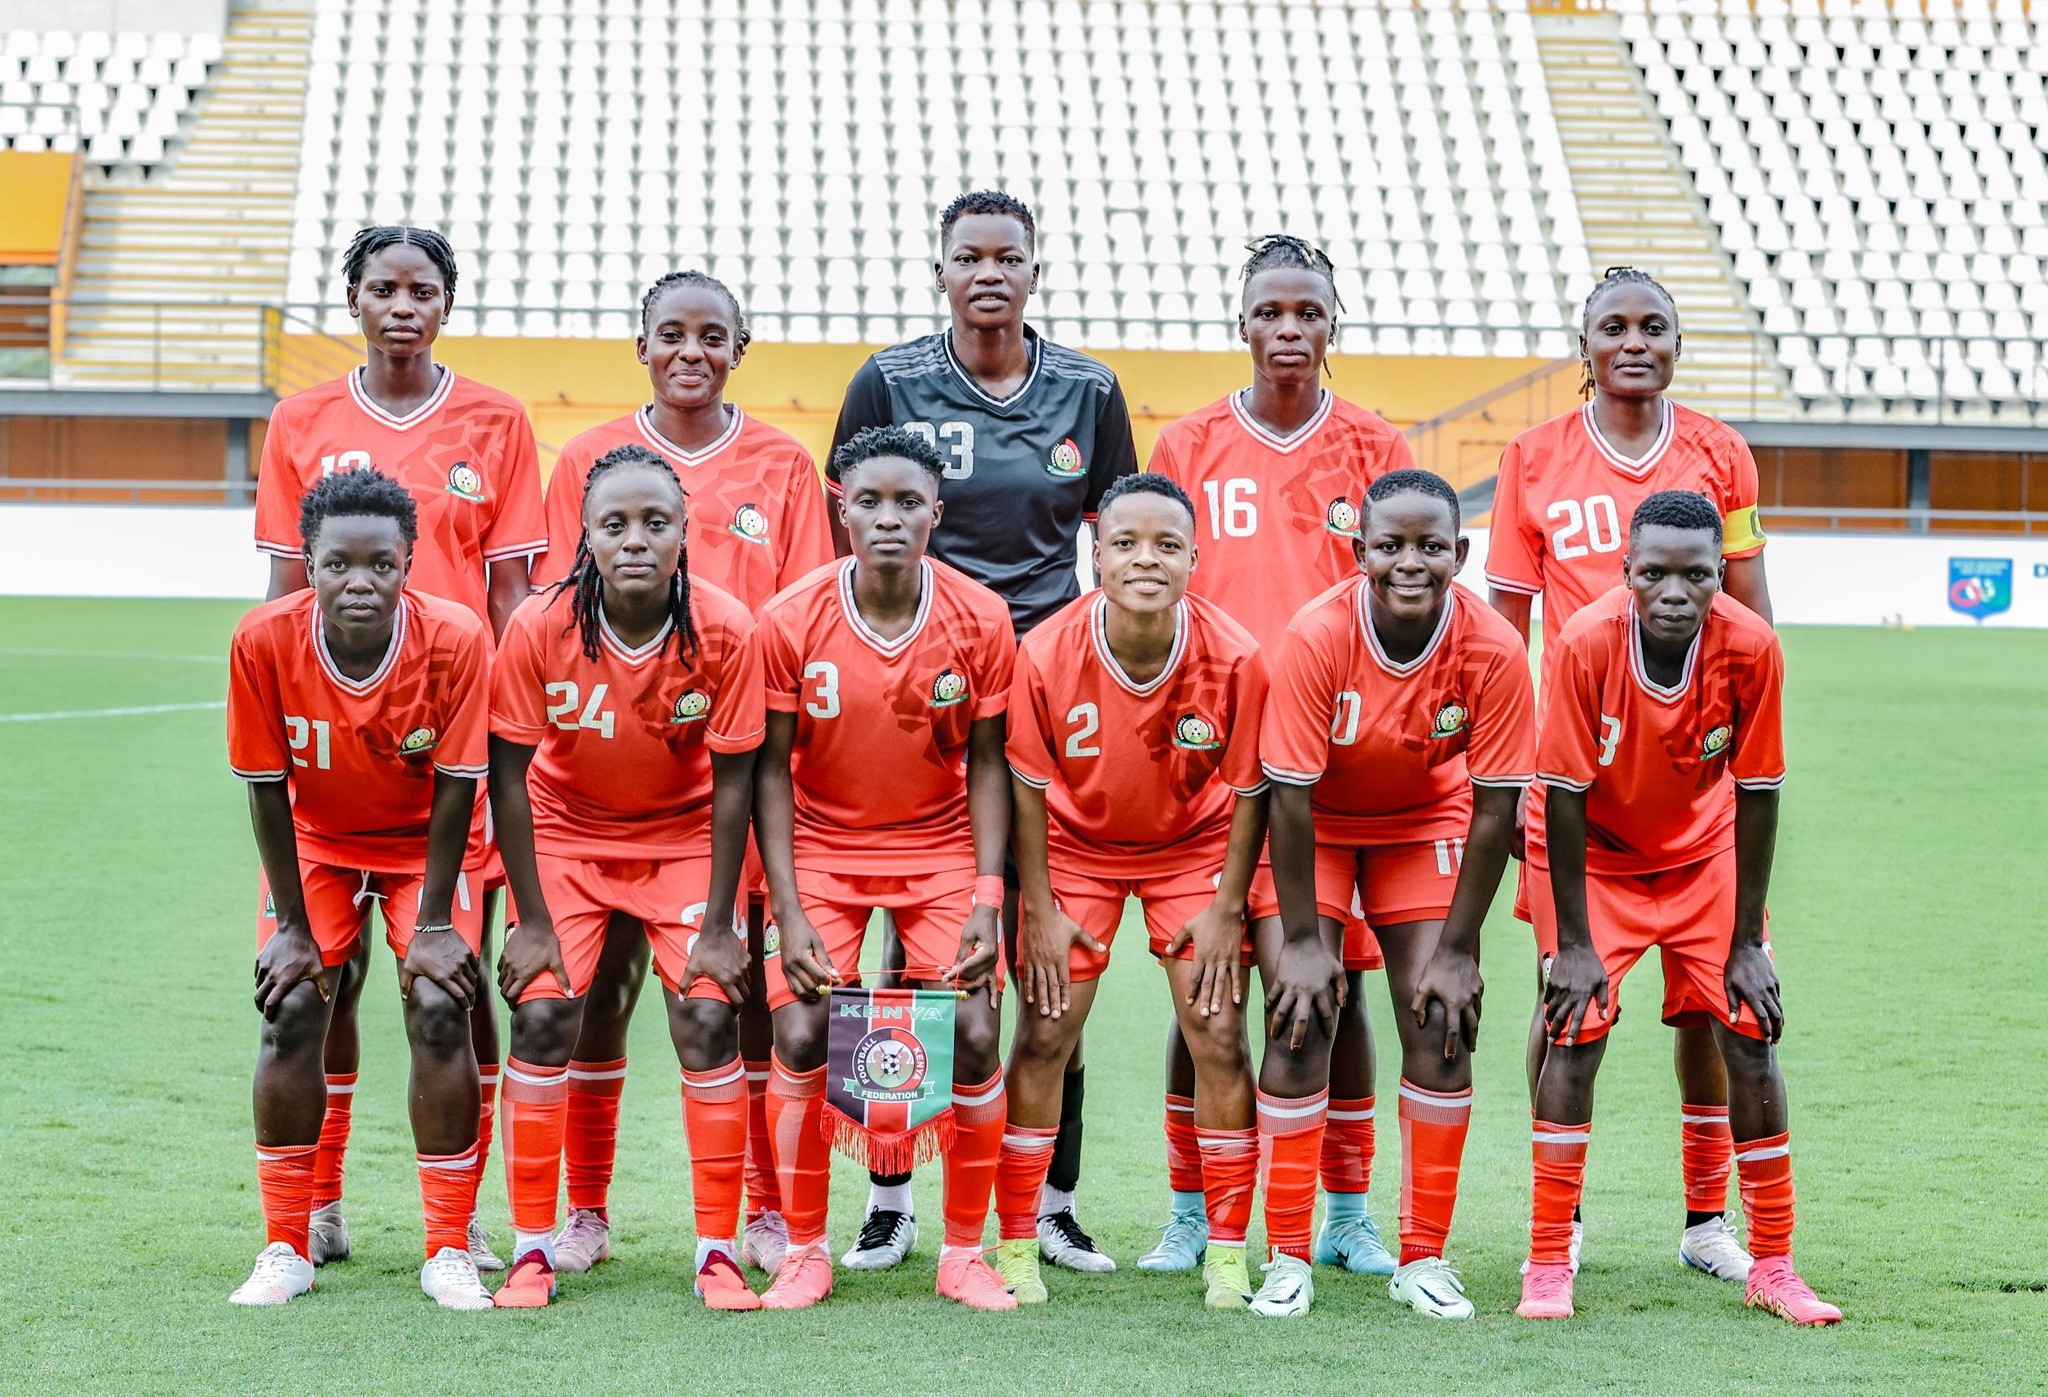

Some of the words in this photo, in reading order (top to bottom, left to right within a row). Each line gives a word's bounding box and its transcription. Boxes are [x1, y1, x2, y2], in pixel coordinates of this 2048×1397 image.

[1202, 477, 1257, 541] 16
[1546, 494, 1622, 561] 20
[545, 680, 615, 739] 24
[803, 661, 841, 719] 3
[284, 714, 330, 770] 21
[1065, 702, 1100, 758] 2
[840, 1004, 944, 1022] KENYA
[857, 1038, 877, 1085] FOOTBALL
[912, 1046, 925, 1081] KENYA
[861, 1090, 918, 1101] FEDERATION
